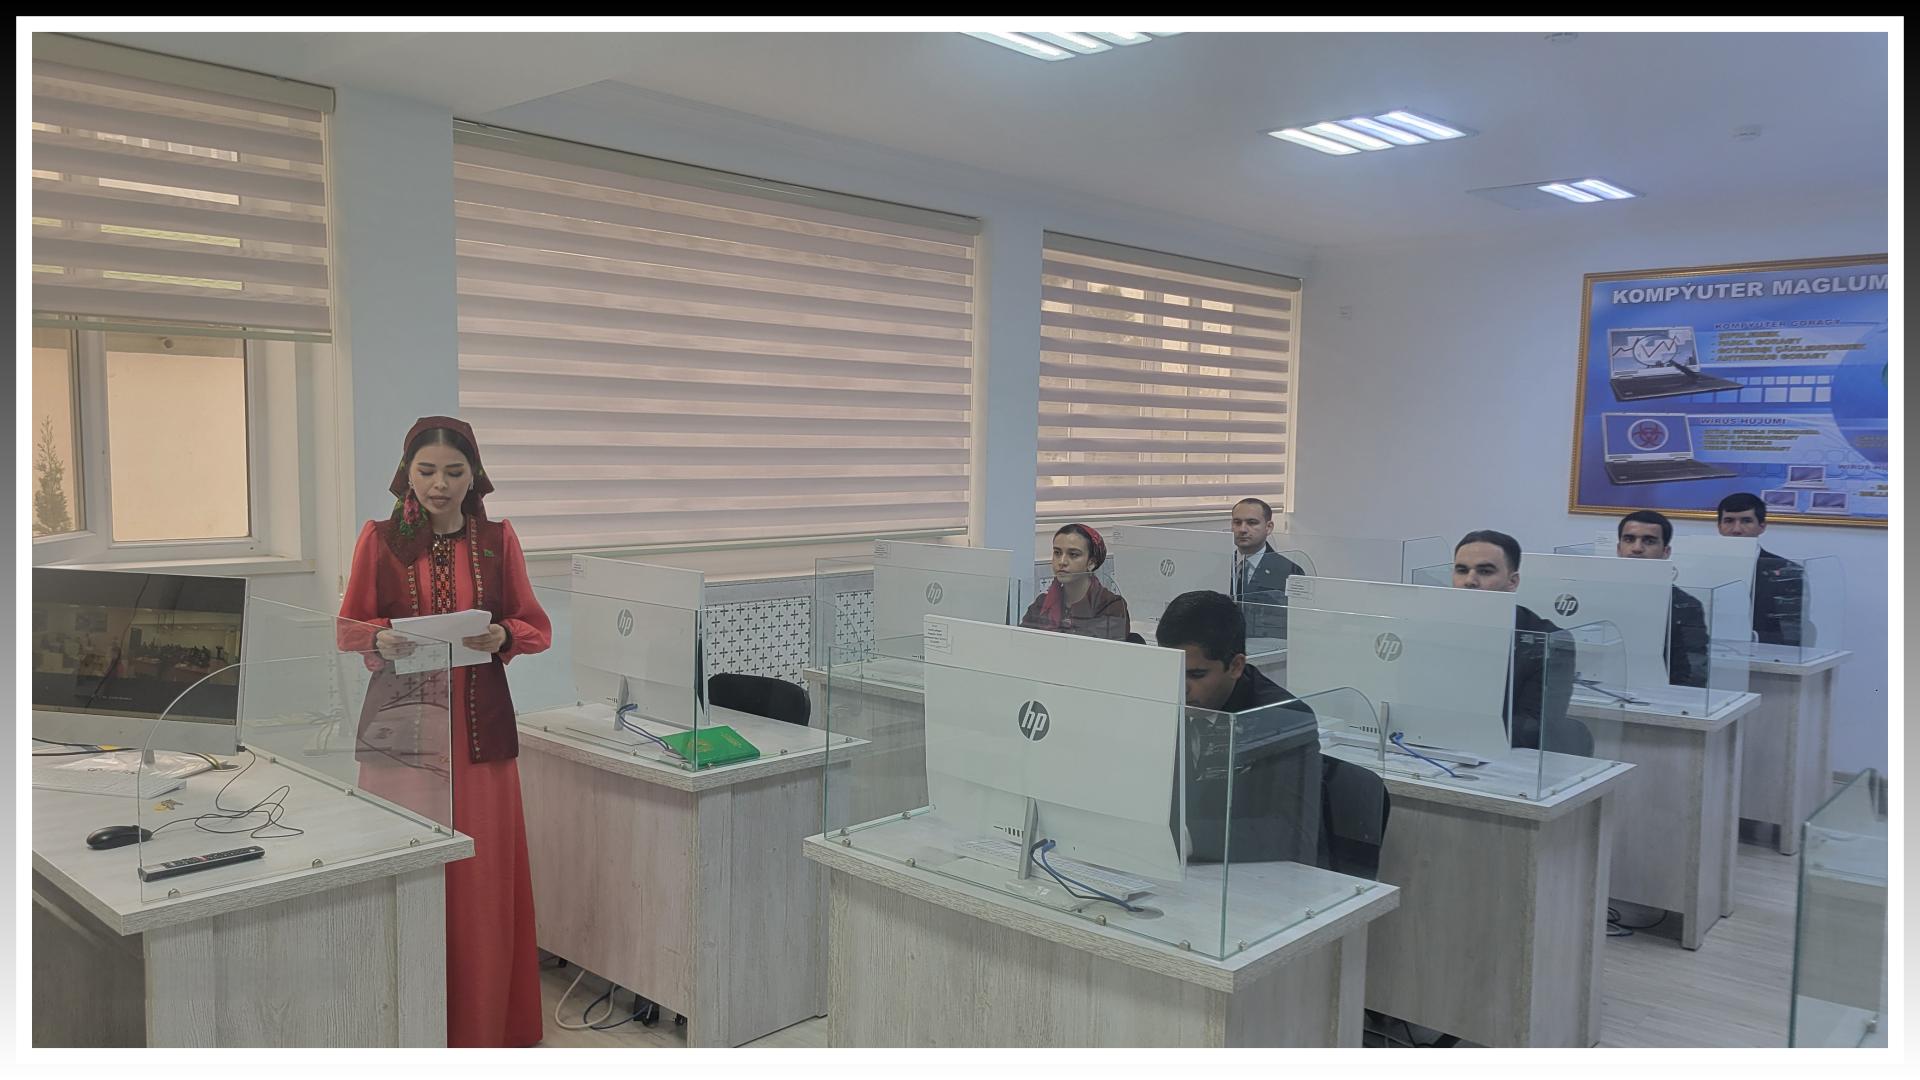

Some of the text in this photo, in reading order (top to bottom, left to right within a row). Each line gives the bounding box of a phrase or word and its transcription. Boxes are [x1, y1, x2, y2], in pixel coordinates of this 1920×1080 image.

[1612, 274, 1888, 304] KOMPÝUTER MAGLUM
[1554, 593, 1578, 616] hp
[617, 609, 633, 635] hp
[1375, 633, 1402, 661] hp
[1019, 700, 1050, 741] hp
